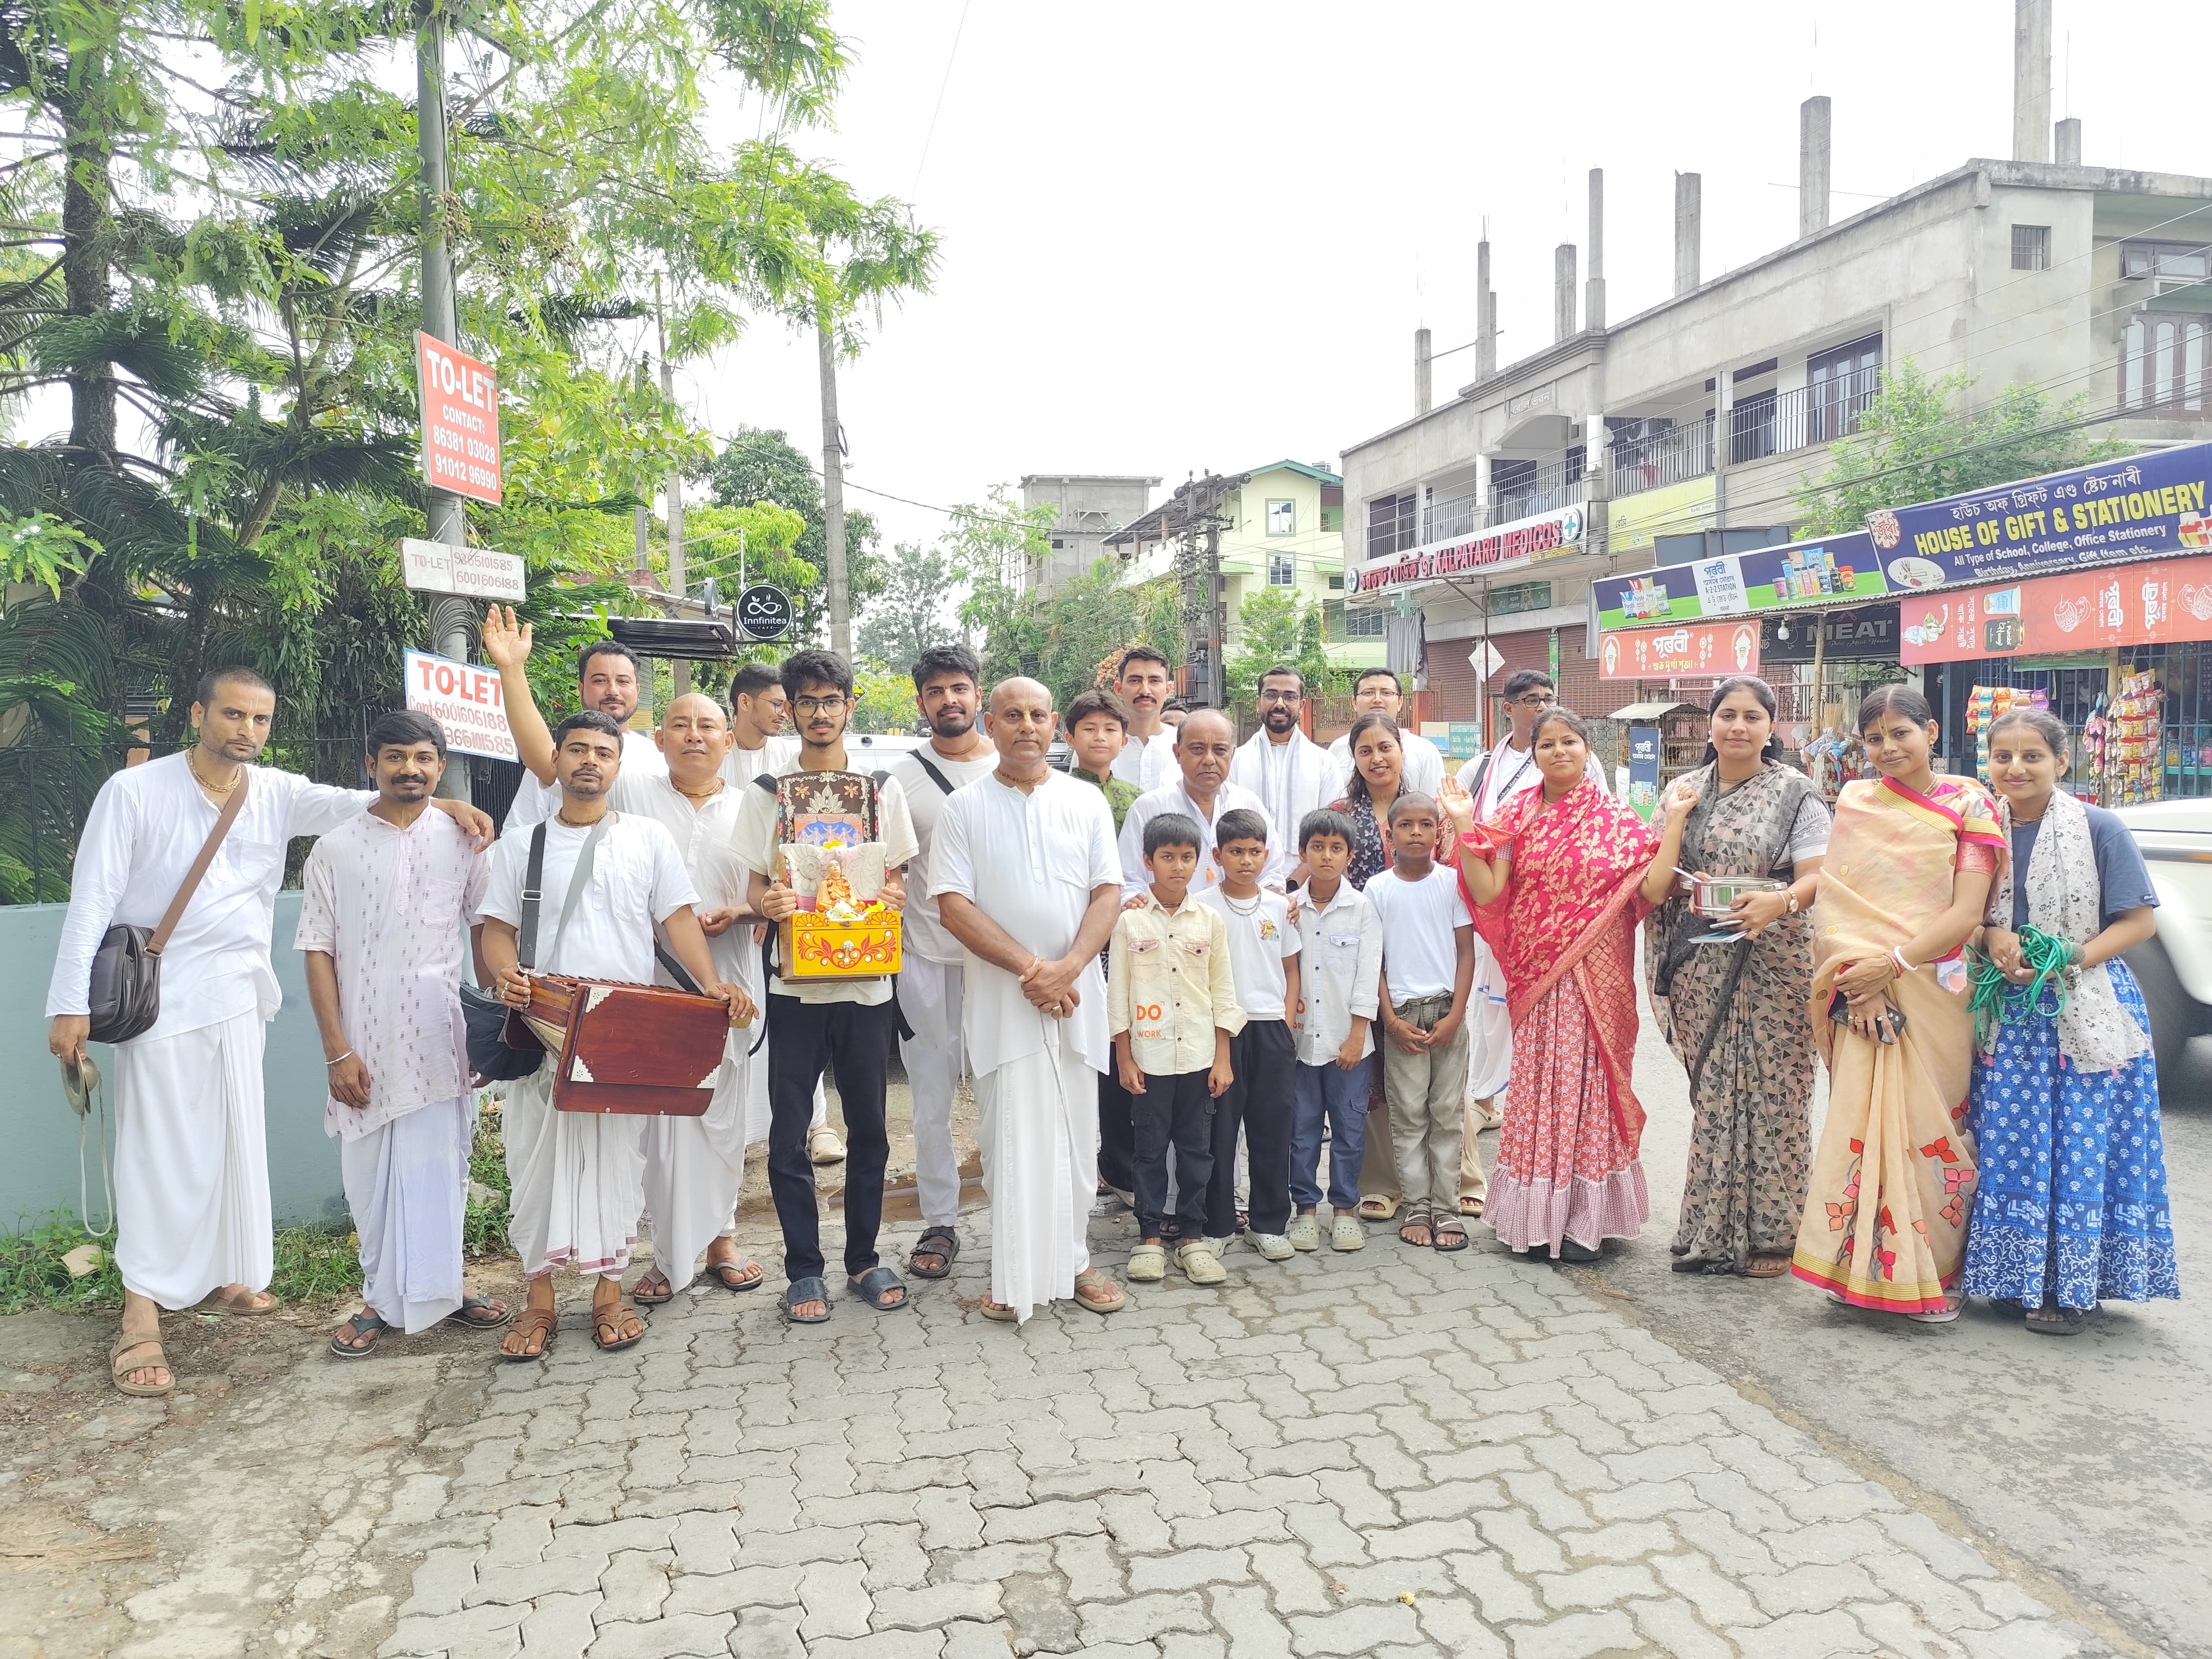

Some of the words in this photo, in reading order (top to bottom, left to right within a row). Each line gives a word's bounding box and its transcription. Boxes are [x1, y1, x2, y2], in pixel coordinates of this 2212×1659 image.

[426, 348, 494, 413] TO-LET
[442, 404, 485, 435] CONTACT:
[433, 425, 464, 454] 86381
[467, 437, 496, 465] 03028
[435, 453, 466, 482] 91012
[469, 465, 497, 491] 96990
[1914, 524, 1974, 556] HOUSE
[1976, 519, 2000, 545] OF
[2005, 510, 2047, 541] GIFT
[2053, 507, 2069, 533] &
[2072, 480, 2205, 530] STATIONERY
[1435, 536, 1501, 574] KALPATARU
[1502, 520, 1562, 559] MEDICOS
[1954, 555, 1964, 567] All
[1965, 552, 1984, 566] Type
[1986, 551, 1995, 561] of
[1996, 545, 2031, 560] School,
[2031, 540, 2073, 554] College,
[2074, 534, 2106, 546] Office
[2108, 525, 2166, 541] Stationery
[411, 554, 451, 570] TO-LET
[1973, 565, 2018, 578] Birthday,
[2078, 550, 2099, 562] Gift
[2099, 548, 2128, 560] Item
[2128, 544, 2152, 556] etc.
[456, 570, 519, 590] 6001606188
[1718, 582, 1737, 592] STATION
[743, 616, 787, 625] Innfinitea
[1806, 620, 1893, 641] MEAT
[1846, 639, 1866, 647] Meat
[1652, 661, 1664, 671] শুভ
[1679, 660, 1693, 672] পূজা
[417, 660, 502, 707] TO-LET
[444, 726, 514, 756] 365101585
[1198, 924, 1211, 933] FAS
[1136, 1004, 1162, 1020] DO
[1296, 999, 1306, 1014] O
[1137, 1029, 1162, 1038] WORK
[1293, 1021, 1304, 1030] ORK
